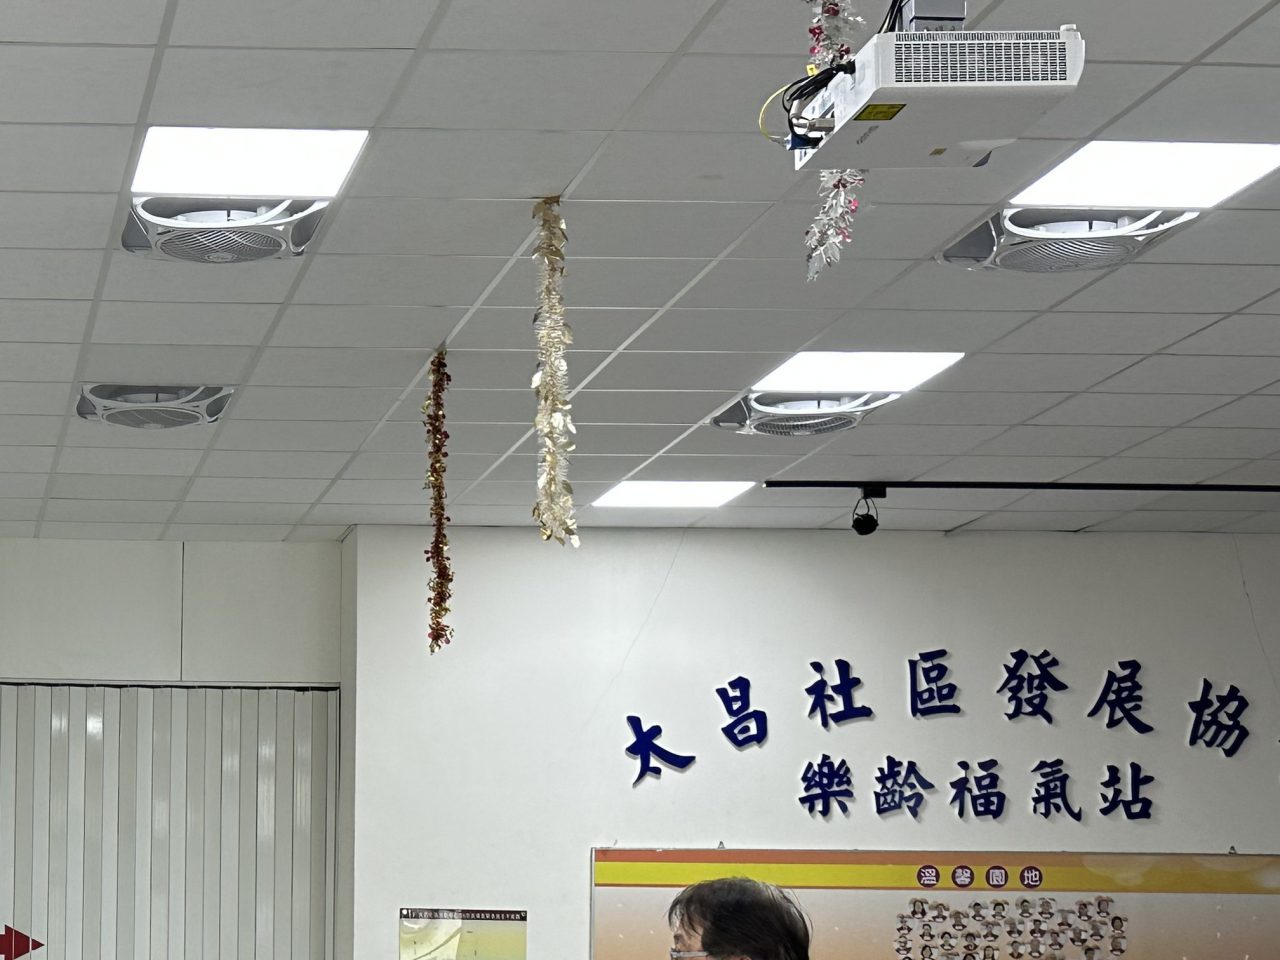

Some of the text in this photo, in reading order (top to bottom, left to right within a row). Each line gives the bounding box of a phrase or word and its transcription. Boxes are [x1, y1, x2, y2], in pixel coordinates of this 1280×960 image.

[798, 754, 1155, 820] 樂齡福氣站
